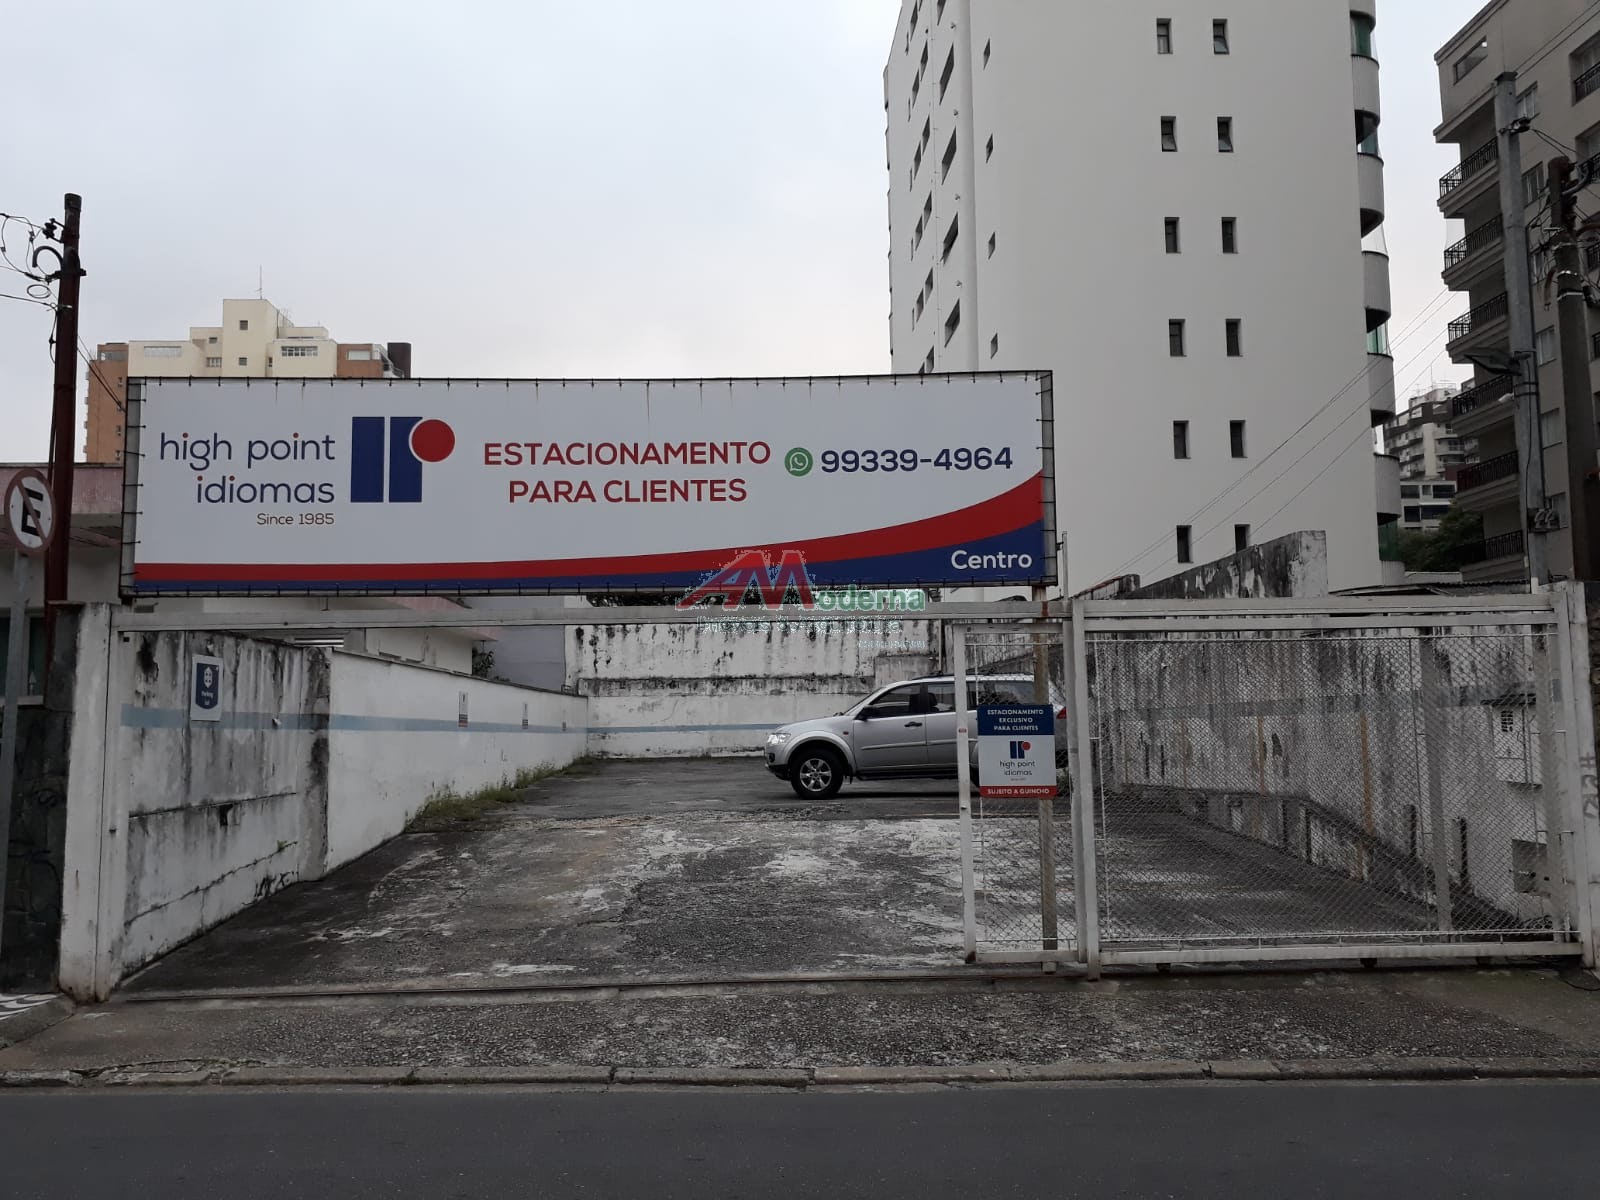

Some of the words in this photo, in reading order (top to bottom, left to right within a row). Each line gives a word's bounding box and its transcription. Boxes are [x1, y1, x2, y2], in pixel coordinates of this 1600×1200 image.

[160, 432, 232, 471] high
[247, 432, 336, 469] point
[485, 440, 771, 466] ESTACIONAMENTO
[820, 446, 1014, 473] 99339-4964
[196, 475, 335, 503] idiomas
[509, 480, 597, 503] PARA
[603, 478, 748, 502] CLIENTES
[256, 512, 294, 525] Since
[298, 512, 335, 525] 1985
[951, 549, 1033, 570] Centro
[999, 760, 1015, 769] high
[1017, 760, 1035, 768] point
